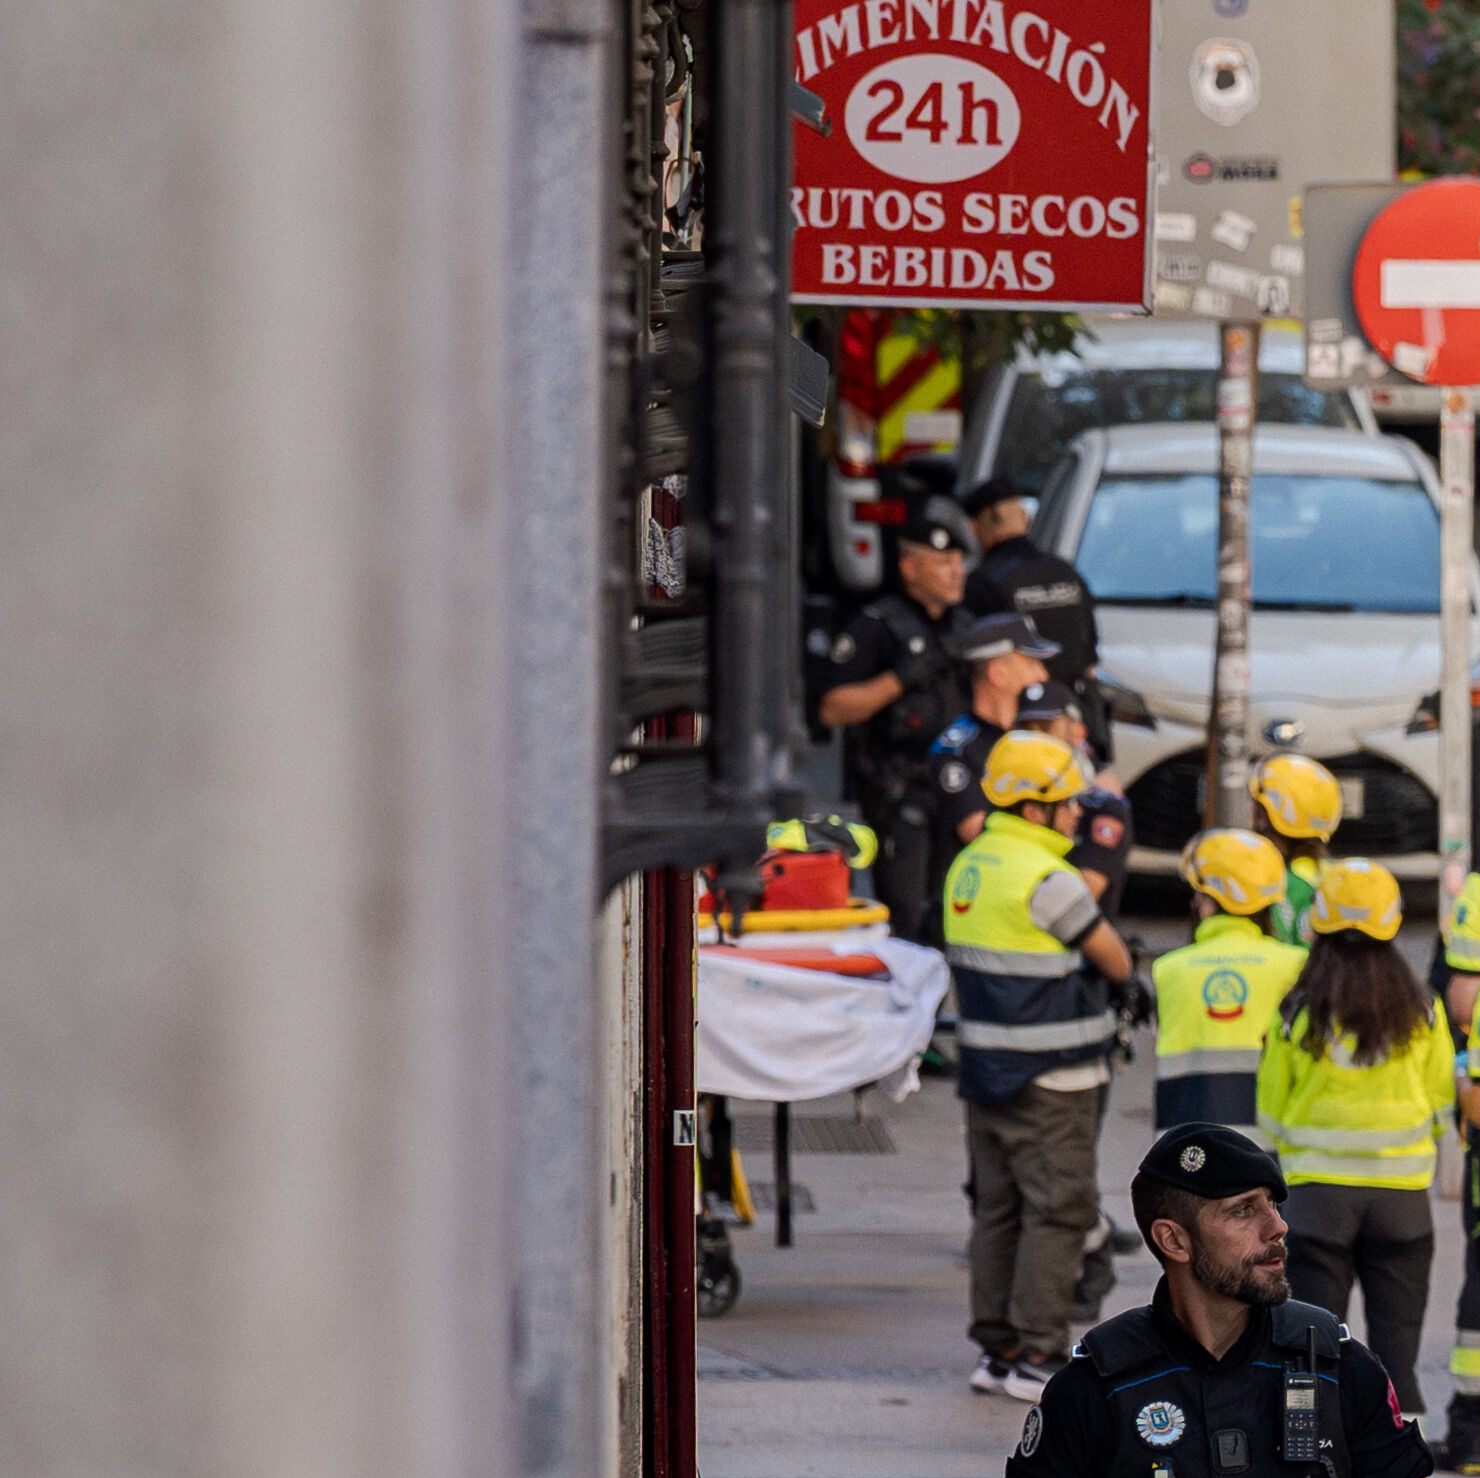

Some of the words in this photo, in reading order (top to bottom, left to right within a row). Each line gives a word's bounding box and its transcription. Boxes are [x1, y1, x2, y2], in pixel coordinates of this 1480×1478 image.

[794, 0, 1140, 153] IMENTACIÓN
[865, 78, 1003, 146] 24h
[962, 193, 1141, 239] SECOS
[821, 244, 1056, 292] BEBIDAS
